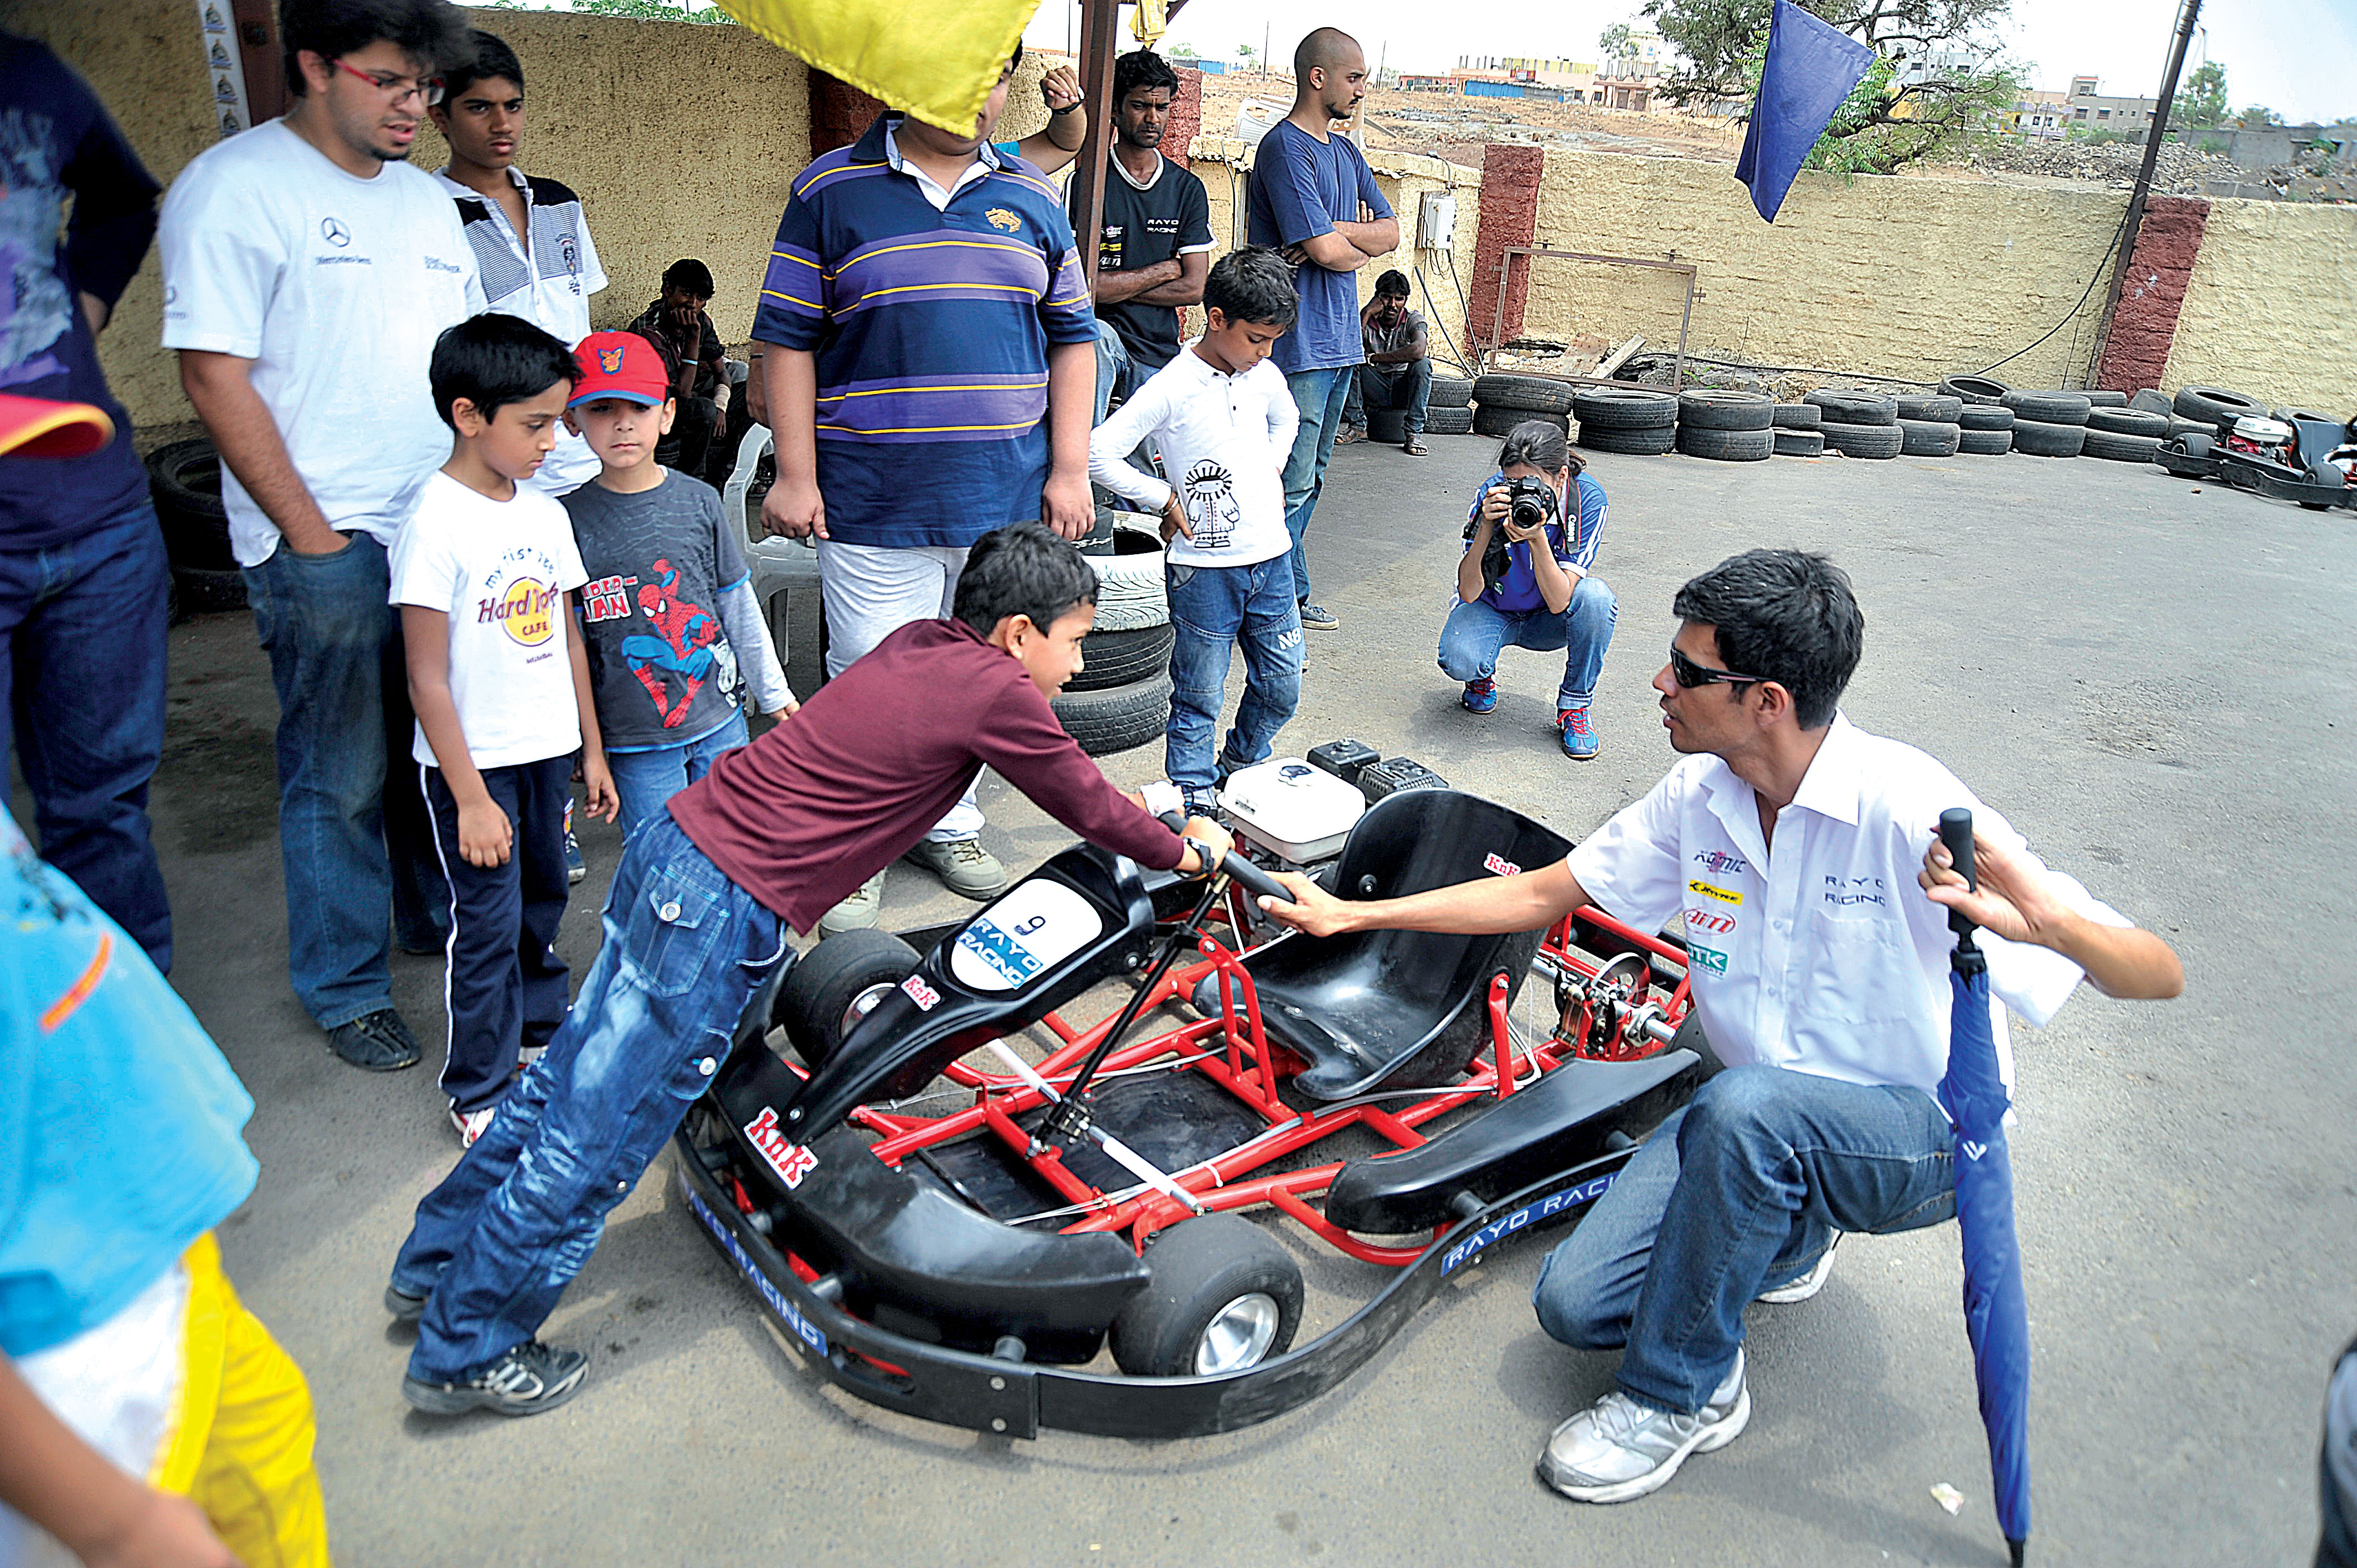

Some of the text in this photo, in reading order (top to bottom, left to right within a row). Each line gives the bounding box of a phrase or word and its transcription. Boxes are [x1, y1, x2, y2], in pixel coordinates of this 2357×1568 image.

[477, 589, 531, 623] Hard
[522, 621, 548, 636] CAFE
[584, 592, 632, 622] AN
[958, 931, 1025, 986] RACING
[975, 920, 1041, 971] RAYO
[1447, 1175, 1614, 1269] RAYO RACI
[734, 1244, 819, 1346] RACING
